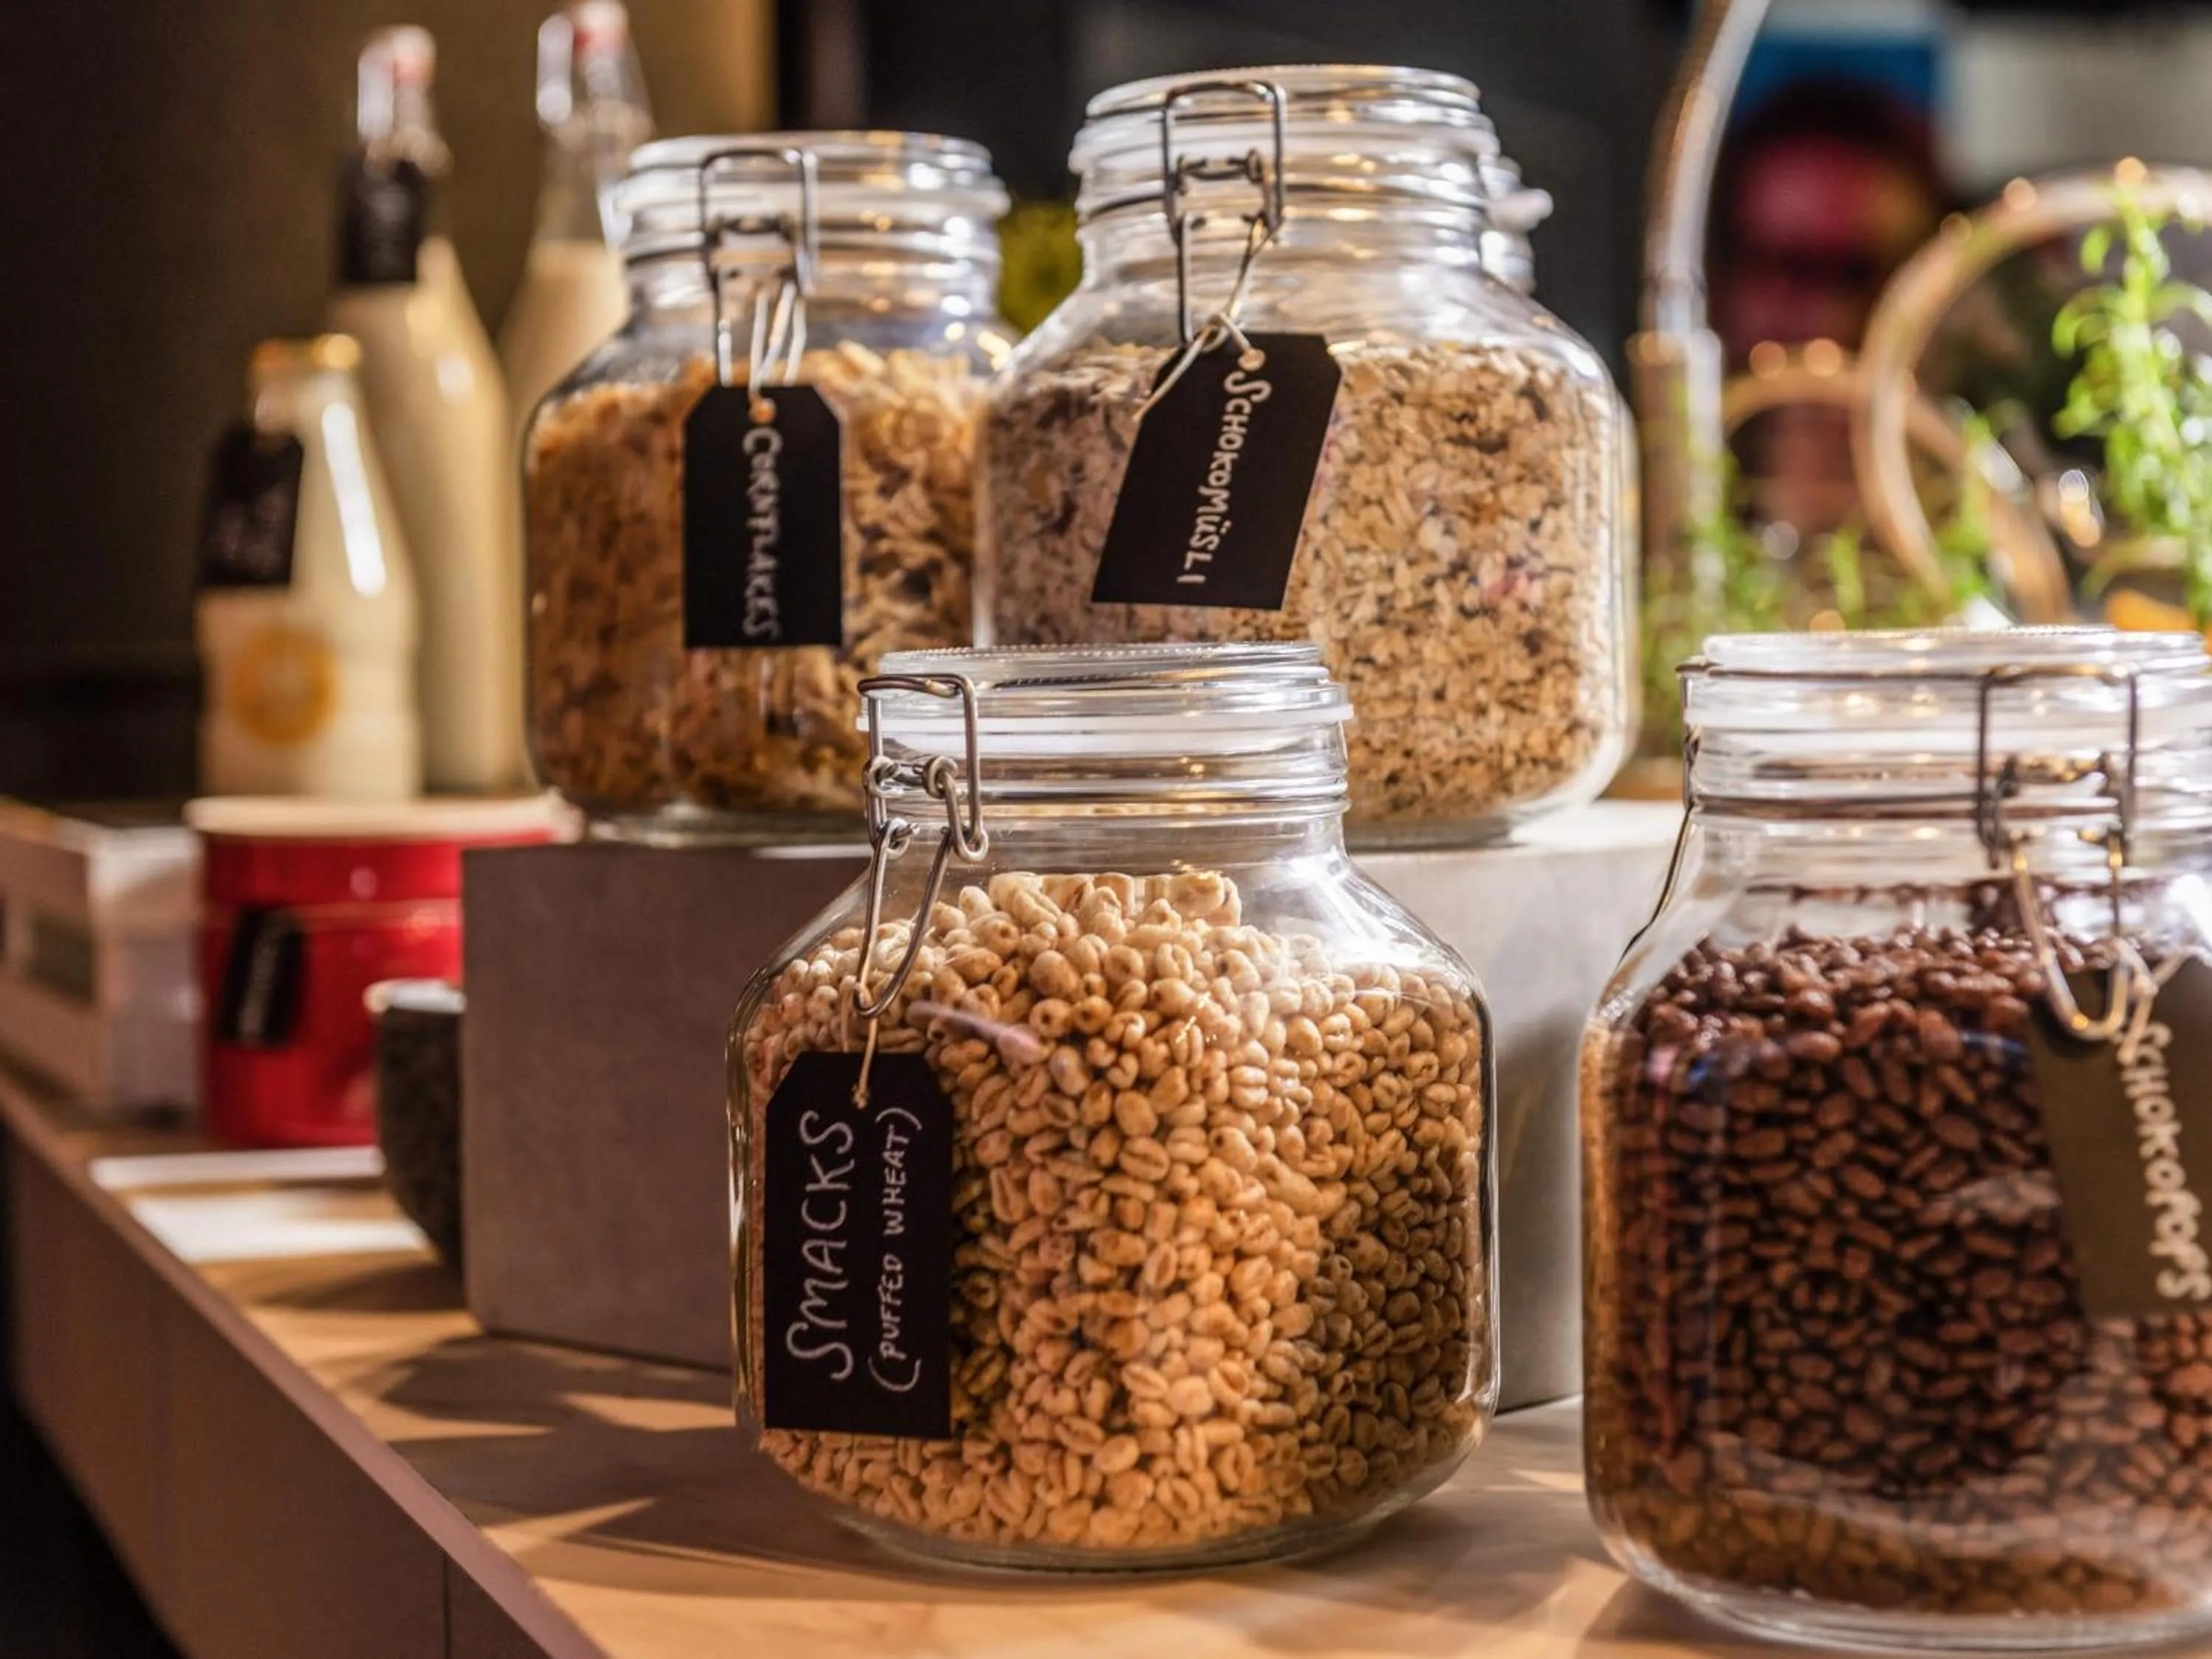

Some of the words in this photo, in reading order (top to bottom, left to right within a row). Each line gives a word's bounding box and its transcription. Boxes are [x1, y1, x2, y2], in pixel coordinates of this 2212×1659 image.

[742, 427, 783, 639] CORNFLAKES
[786, 1110, 855, 1380] SMACKS
[875, 1107, 922, 1236] WHEAT)
[868, 1255, 921, 1392] (PUFFED
